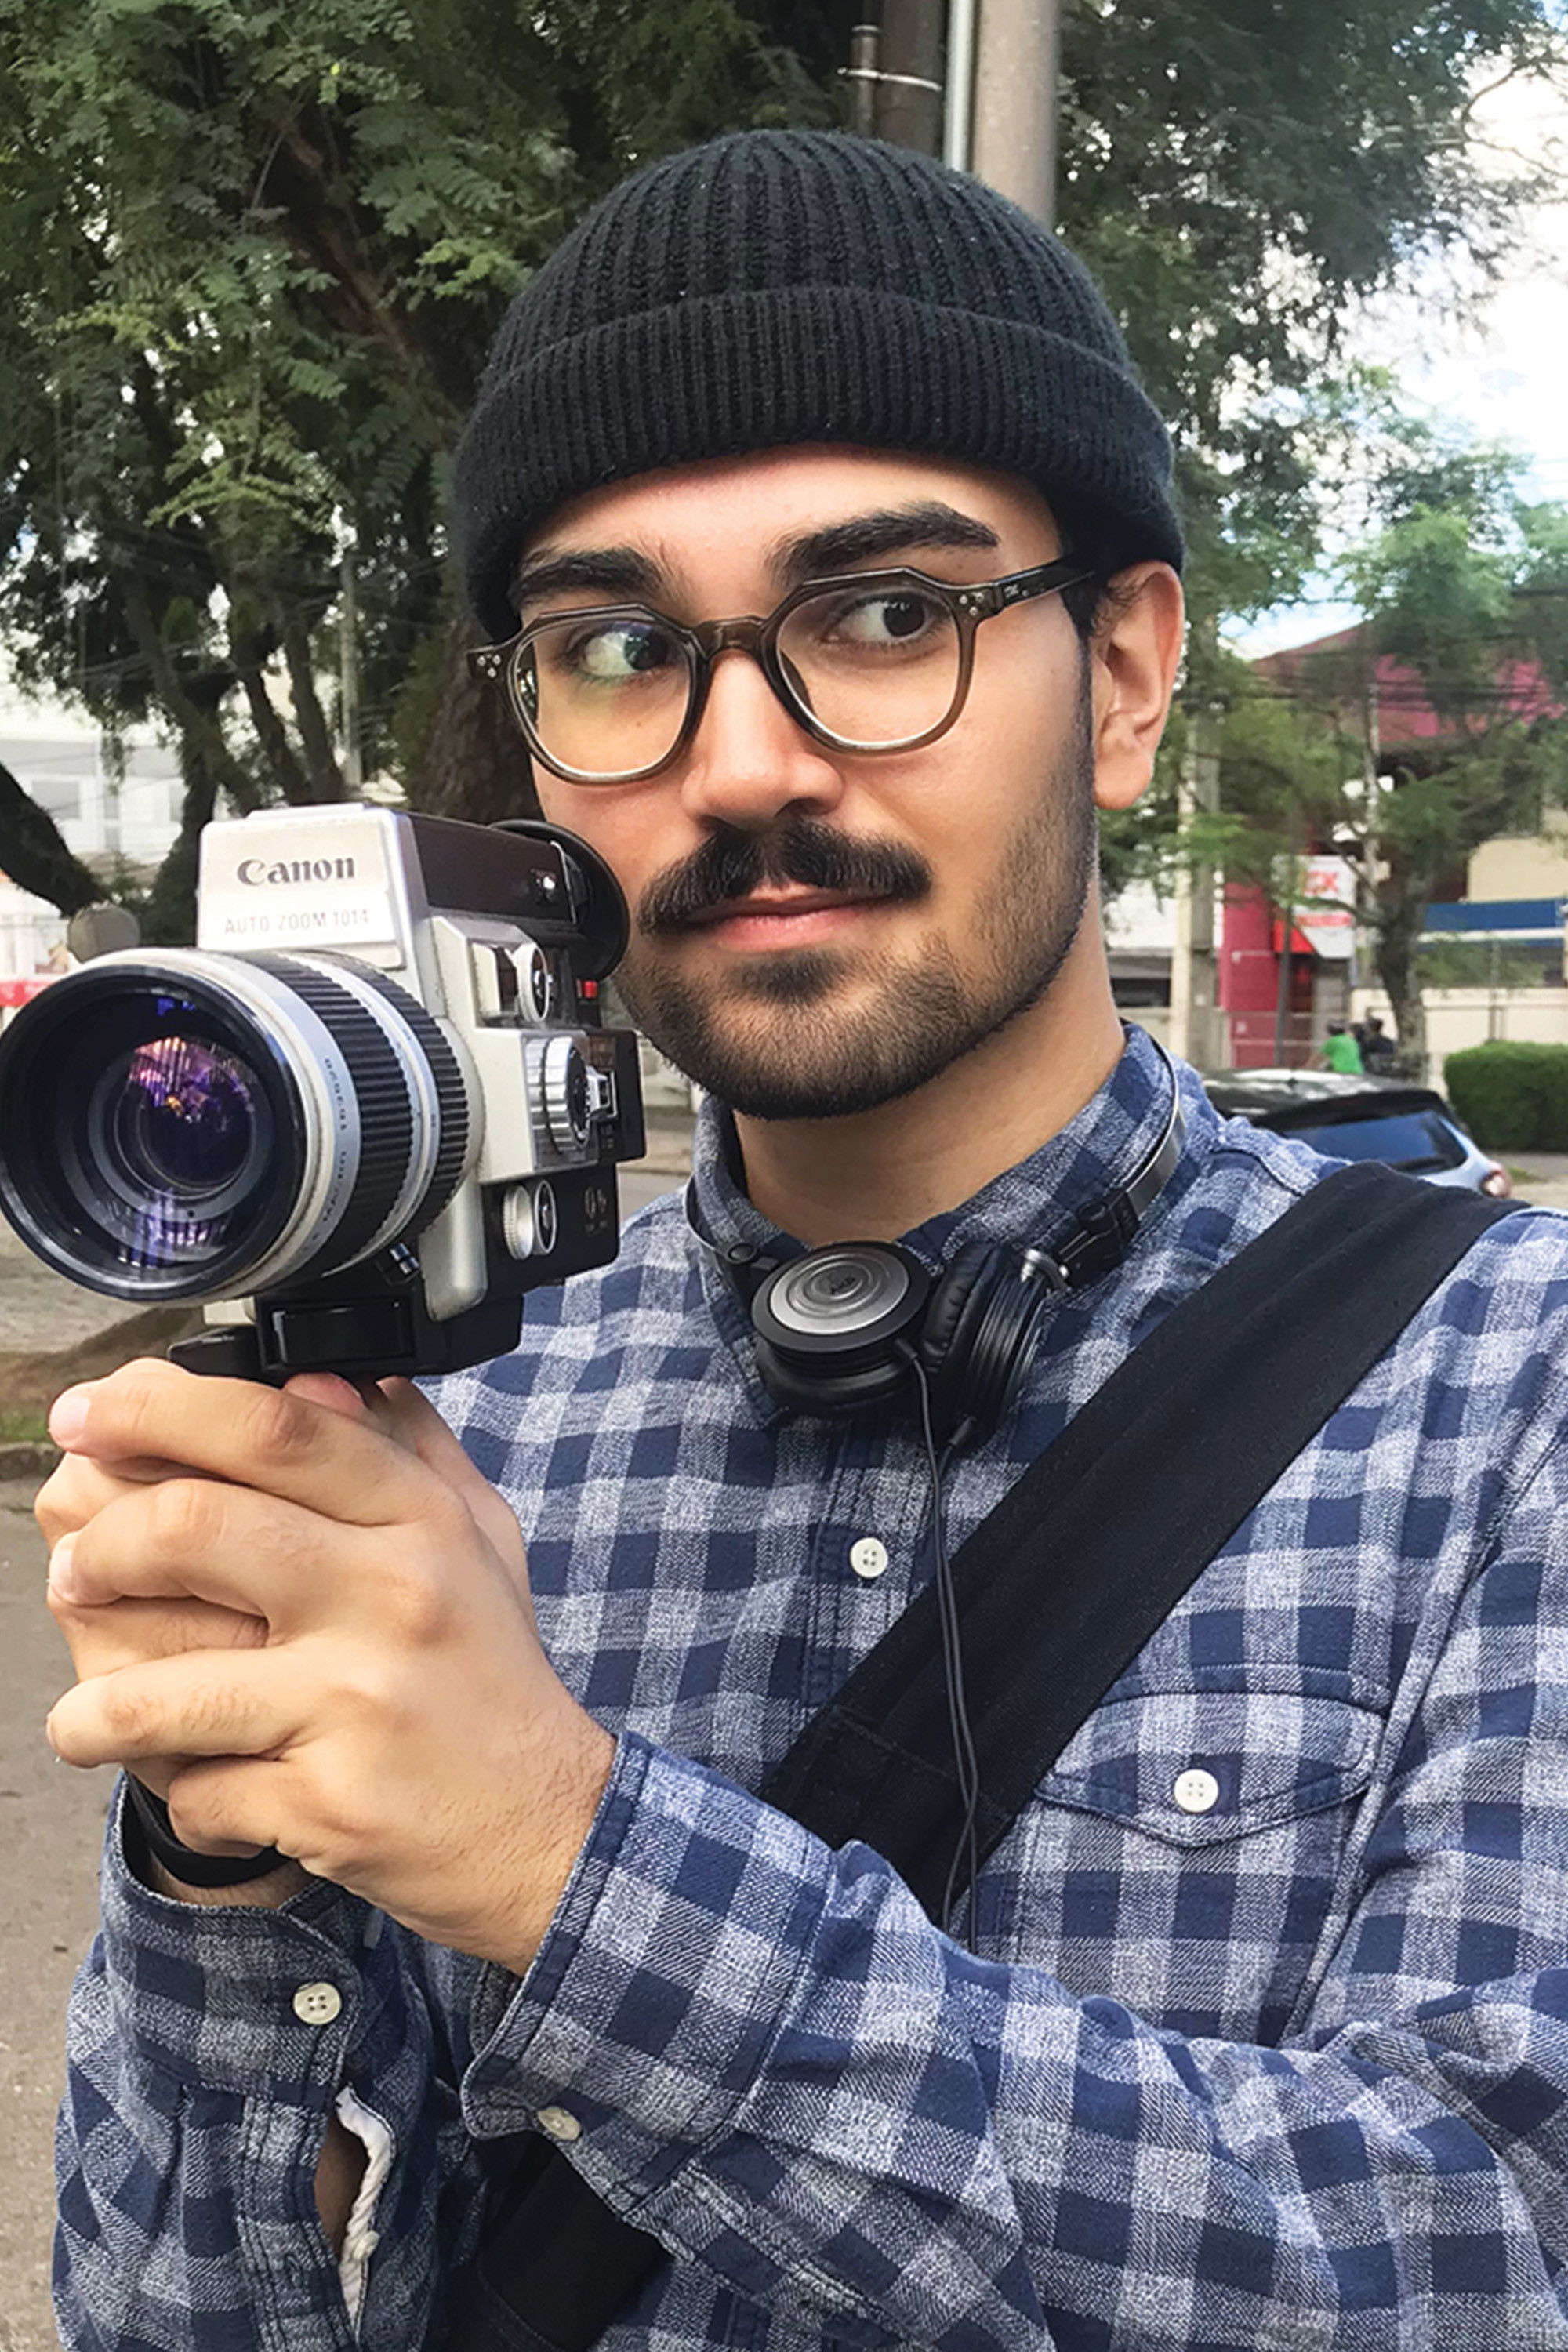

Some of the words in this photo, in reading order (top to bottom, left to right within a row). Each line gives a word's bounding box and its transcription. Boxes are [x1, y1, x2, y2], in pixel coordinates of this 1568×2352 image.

[237, 858, 354, 886] Canon
[225, 916, 270, 935] AUTO
[278, 912, 327, 931] ZOOM
[333, 909, 369, 927] 1014
